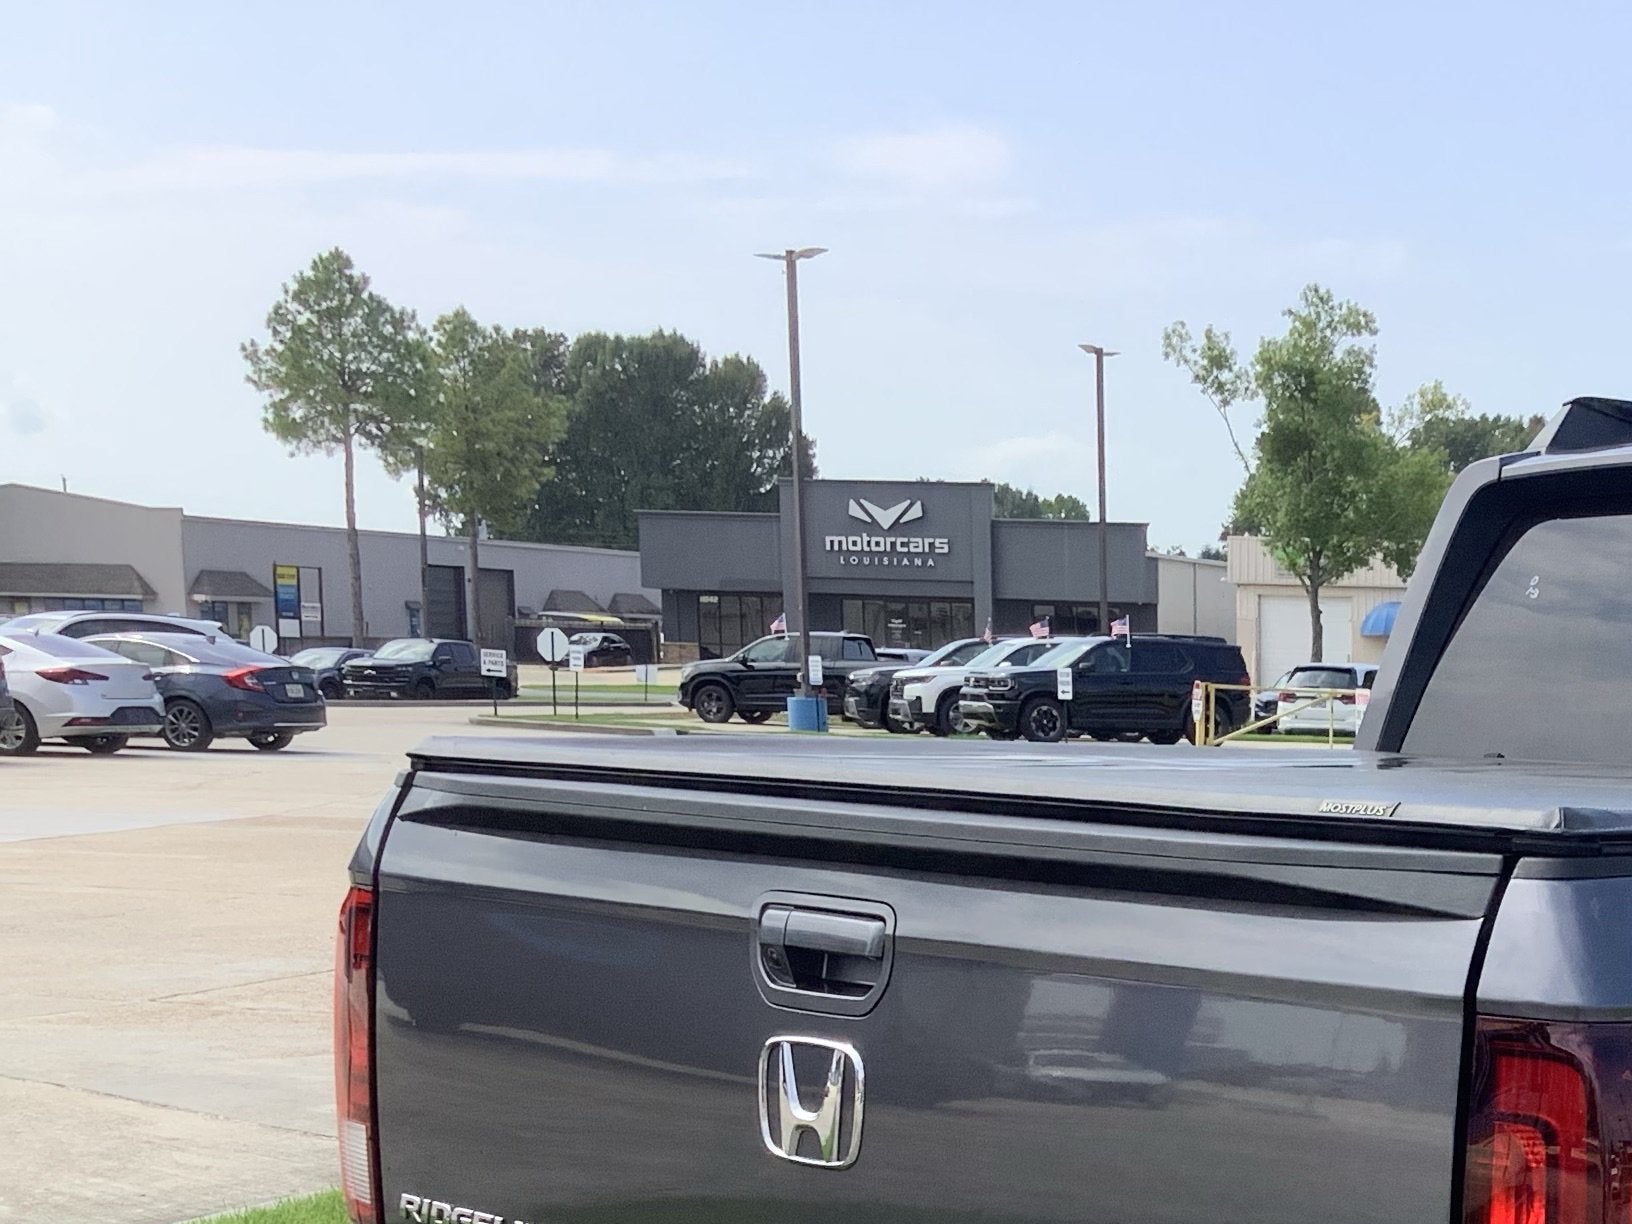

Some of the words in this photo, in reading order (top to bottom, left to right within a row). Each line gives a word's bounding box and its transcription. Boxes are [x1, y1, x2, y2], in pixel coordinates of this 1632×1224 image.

[825, 533, 949, 553] motorcars
[840, 556, 935, 567] LOUISIANA
[1319, 800, 1386, 816] MOSTPLUS
